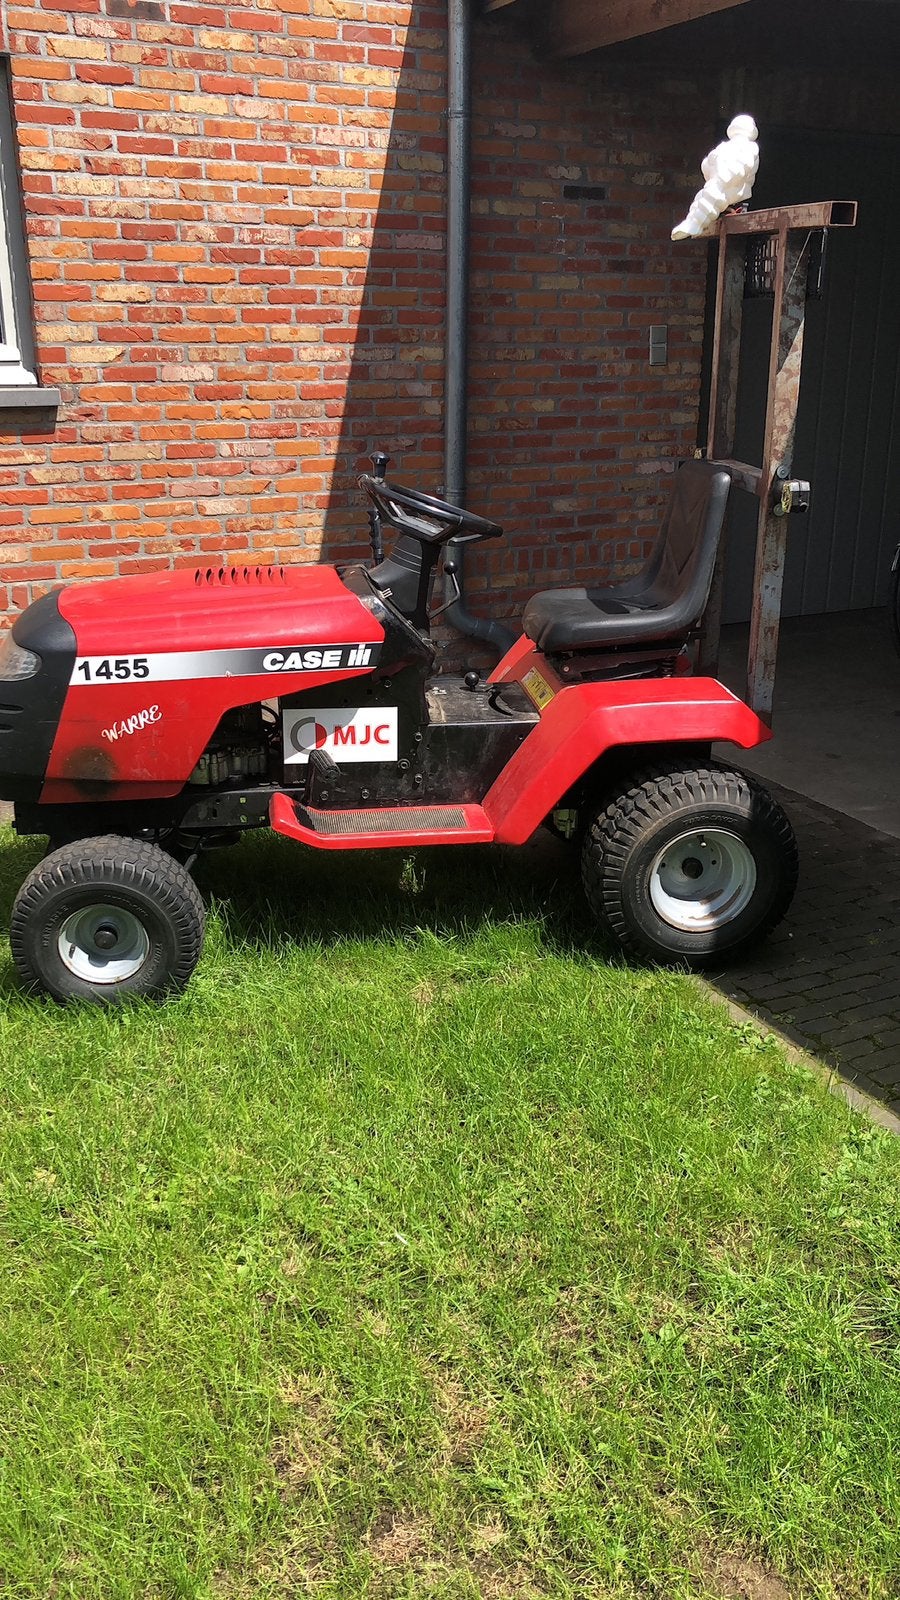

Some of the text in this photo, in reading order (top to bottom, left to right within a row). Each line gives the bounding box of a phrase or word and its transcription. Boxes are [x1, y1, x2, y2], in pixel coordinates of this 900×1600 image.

[78, 658, 150, 681] 1455
[262, 650, 343, 672] CASE
[101, 704, 163, 743] WARRE
[333, 724, 390, 746] MJC
